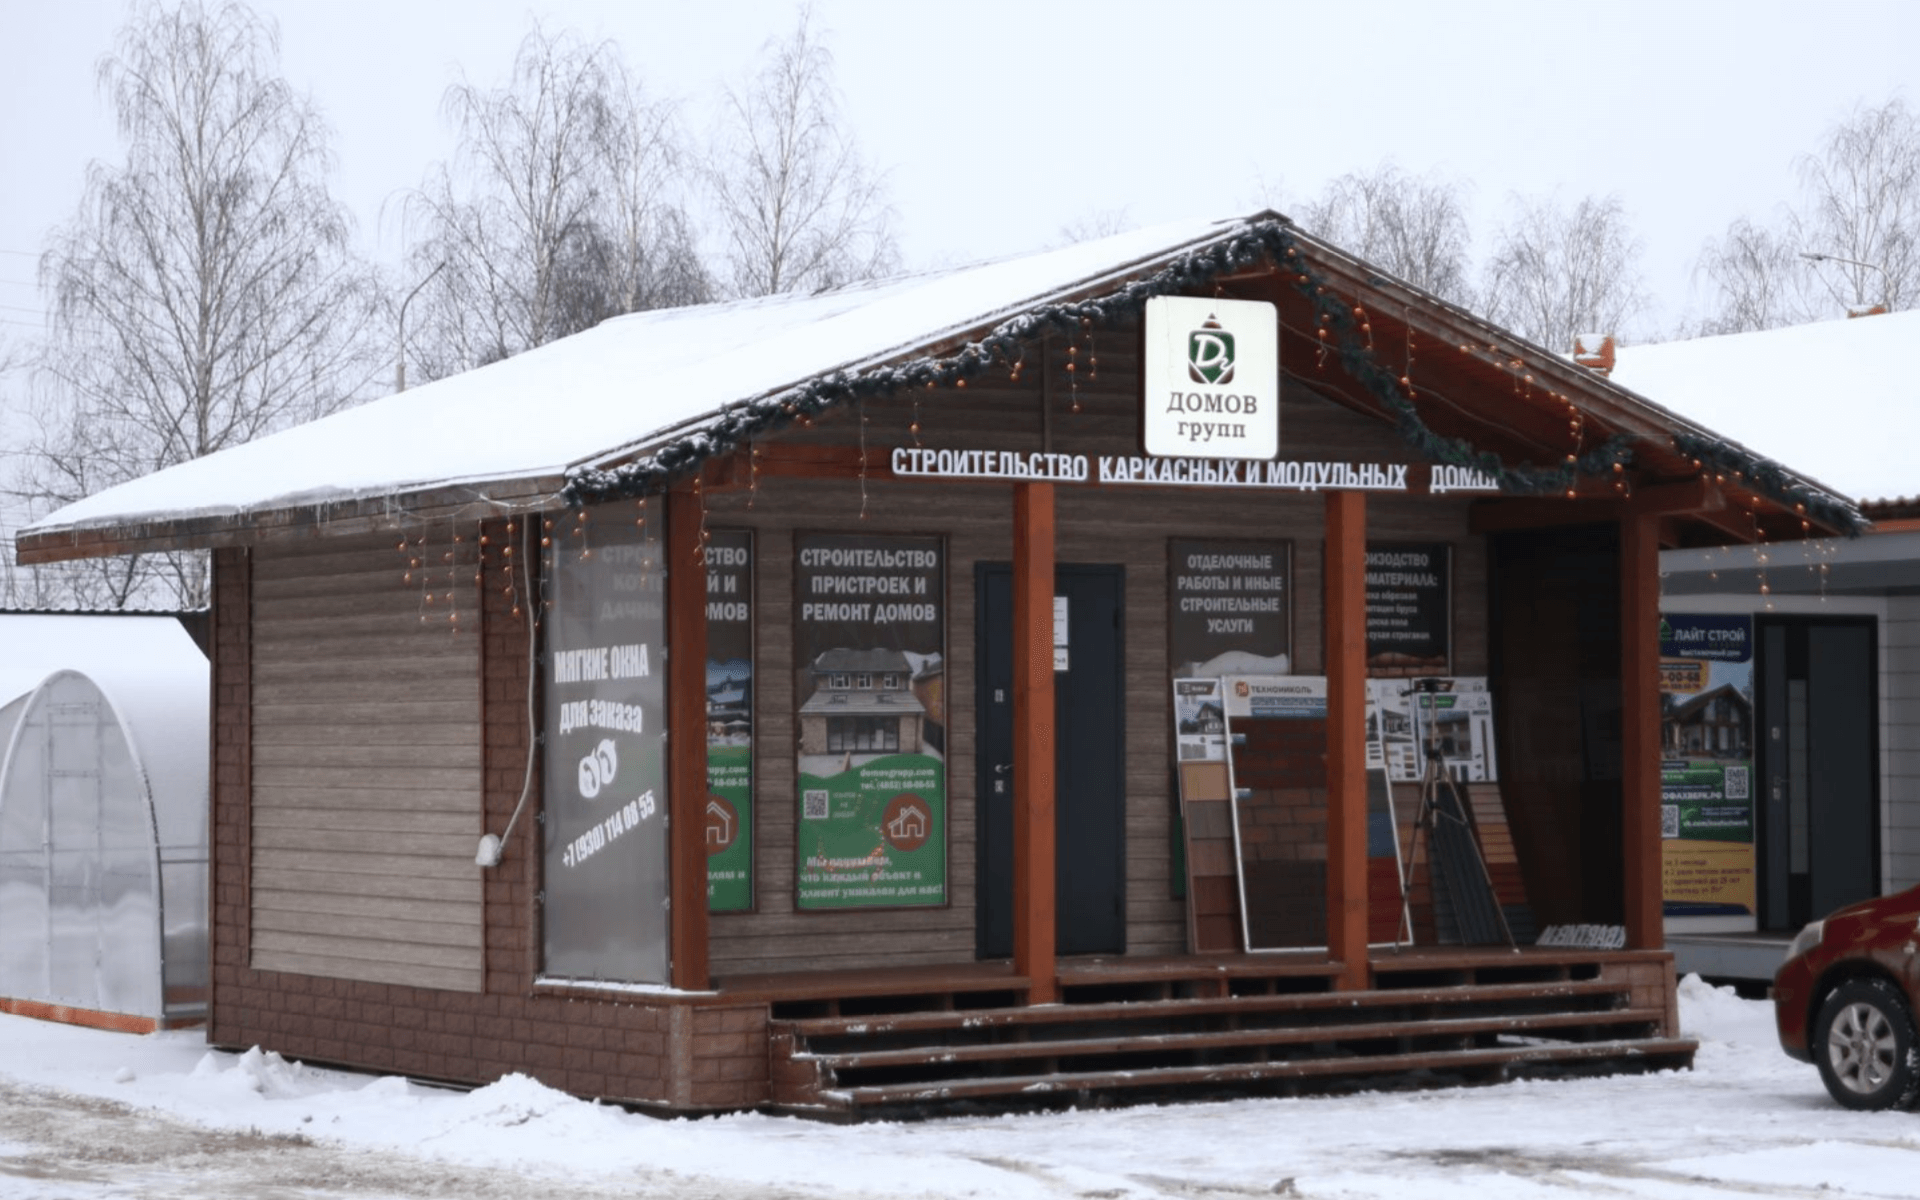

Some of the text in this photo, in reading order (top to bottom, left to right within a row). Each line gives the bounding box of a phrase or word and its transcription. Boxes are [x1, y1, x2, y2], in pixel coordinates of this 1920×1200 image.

[1166, 392, 1257, 414] ДОМОВ
[1178, 421, 1246, 442] групп
[891, 447, 1088, 481] СТРОИТЕЛЬСТВО
[1099, 456, 1238, 485] КАРКАСНЫХ
[1245, 460, 1260, 486] И
[1266, 461, 1407, 490] МОДУЛЬНЫХ
[800, 549, 937, 568] СТРОИТЕЛЬСТВО
[1187, 555, 1272, 571] ОТДЕЛОЧНЫЕ
[724, 575, 736, 593] И
[811, 576, 926, 594] ПРИСТРОЕК И
[1177, 576, 1282, 590] РАБОТЫ И ИНЫЕ
[1365, 572, 1438, 587] МАТЕРИАЛА:
[706, 602, 748, 620] МОВ
[802, 603, 936, 624] РЕМОНТ ДОМОВ
[1180, 597, 1280, 612] СТРОИТЕЛЬНЫЕ
[1207, 618, 1254, 633] УСЛУГИ
[1674, 626, 1745, 641] ЛАЙТ СТРОЙ
[554, 643, 649, 683] МЯГКИЕ ОКНА
[560, 699, 643, 735] для заказа
[562, 789, 655, 868] +7 (930) 114 08 55
